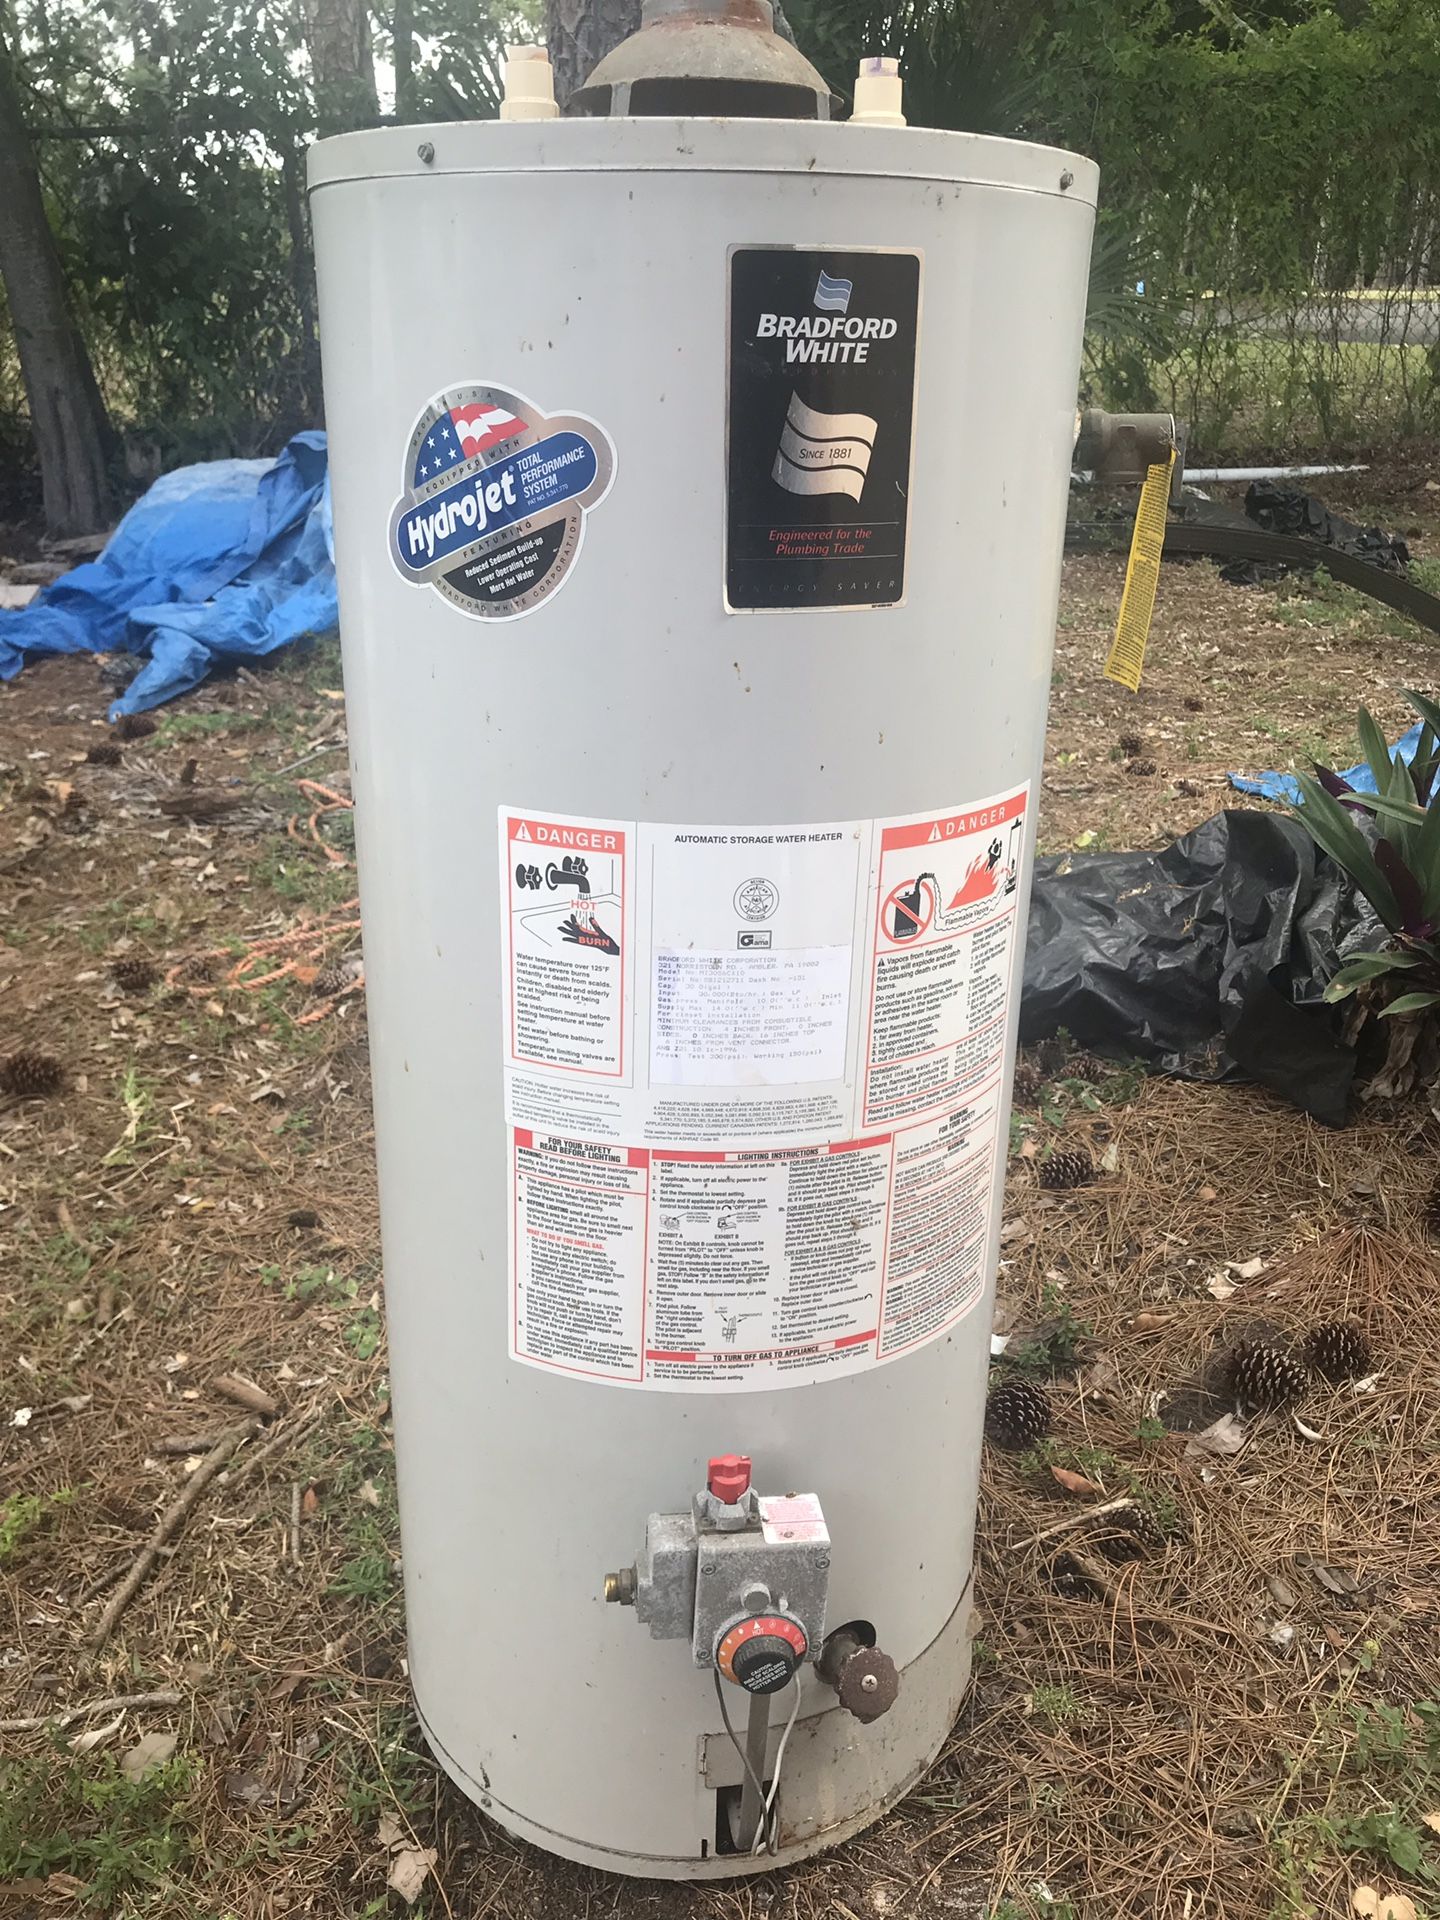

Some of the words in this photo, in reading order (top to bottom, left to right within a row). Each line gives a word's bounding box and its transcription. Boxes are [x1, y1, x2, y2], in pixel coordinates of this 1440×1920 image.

[756, 314, 897, 339] BRADFORD
[786, 339, 870, 363] WHITE
[517, 452, 543, 471] TOTAL
[829, 448, 852, 458] 1881
[426, 459, 480, 493] EQUIPPED
[489, 440, 520, 458] WITH
[521, 446, 585, 485] PERFORMANCE
[524, 474, 558, 498] SYSTEM
[407, 470, 516, 557] Hydrojet
[463, 522, 532, 558] FEATURING
[769, 530, 832, 542] Engineered
[836, 529, 851, 539] for
[855, 528, 872, 539] the
[465, 564, 489, 577] Reduced
[489, 548, 517, 566] Sediment
[517, 537, 544, 555] Build-up
[776, 544, 829, 556] Plumbing
[834, 543, 864, 553] Trade
[436, 580, 486, 612] BRADFORD
[494, 598, 526, 612] WHITE
[533, 517, 577, 598] CORPORATION
[477, 574, 495, 585] Lower
[495, 560, 524, 578] Operating
[524, 553, 539, 564] Cost
[489, 582, 505, 594] More
[505, 577, 516, 588] Hot
[516, 569, 534, 582] Water
[837, 581, 895, 590] SAVER
[946, 807, 1006, 835] DANGER
[537, 827, 616, 849] DANGER
[675, 834, 727, 844] AUTOMATIC
[730, 834, 774, 844] STORAGE
[775, 834, 806, 843] WATER
[809, 832, 842, 842] HEATER
[571, 900, 597, 911] HOT
[945, 913, 974, 926] Flammable
[975, 906, 989, 918] Vapors
[578, 936, 610, 946] BURN
[535, 956, 573, 967] temperature
[878, 966, 899, 975] liquids
[901, 962, 911, 970] will
[912, 958, 935, 968] explode
[947, 949, 960, 958] catch
[887, 955, 909, 964] Vapors
[910, 952, 924, 960] from
[925, 944, 953, 956] flammable
[517, 968, 542, 978] instantly
[529, 963, 547, 971] cause
[571, 970, 590, 978] burns
[889, 971, 913, 981] causing
[915, 966, 931, 975] death
[939, 959, 956, 969] severe
[535, 988, 558, 996] highest
[581, 996, 600, 1004] being
[545, 982, 572, 991] disabled
[587, 990, 609, 998] elderly
[877, 983, 896, 991] burns.
[518, 1008, 537, 1018] setting
[539, 1013, 576, 1024] temperature
[530, 1004, 563, 1014] instruction
[564, 1010, 588, 1018] manual
[531, 1027, 548, 1035] water
[549, 1031, 569, 1039] before
[571, 1034, 595, 1044] bathing
[518, 1040, 555, 1053] Temperature
[556, 1048, 580, 1058] limiting
[540, 1142, 557, 1152] READ
[560, 1146, 586, 1158] BEFORE
[588, 1152, 621, 1163] LIGHTING
[548, 1137, 562, 1145] FOR
[563, 1140, 583, 1150] YOUR
[584, 1144, 611, 1154] SAFETY
[772, 1149, 819, 1159] INSTRUCTIONS
[784, 1346, 819, 1357] APPLIANCE
[748, 1672, 774, 1687] INCREASES
[774, 1666, 786, 1674] WITH
[762, 1660, 785, 1675] SCALDING
[752, 1679, 771, 1690] HOTTER
[771, 1670, 787, 1682] WATER
